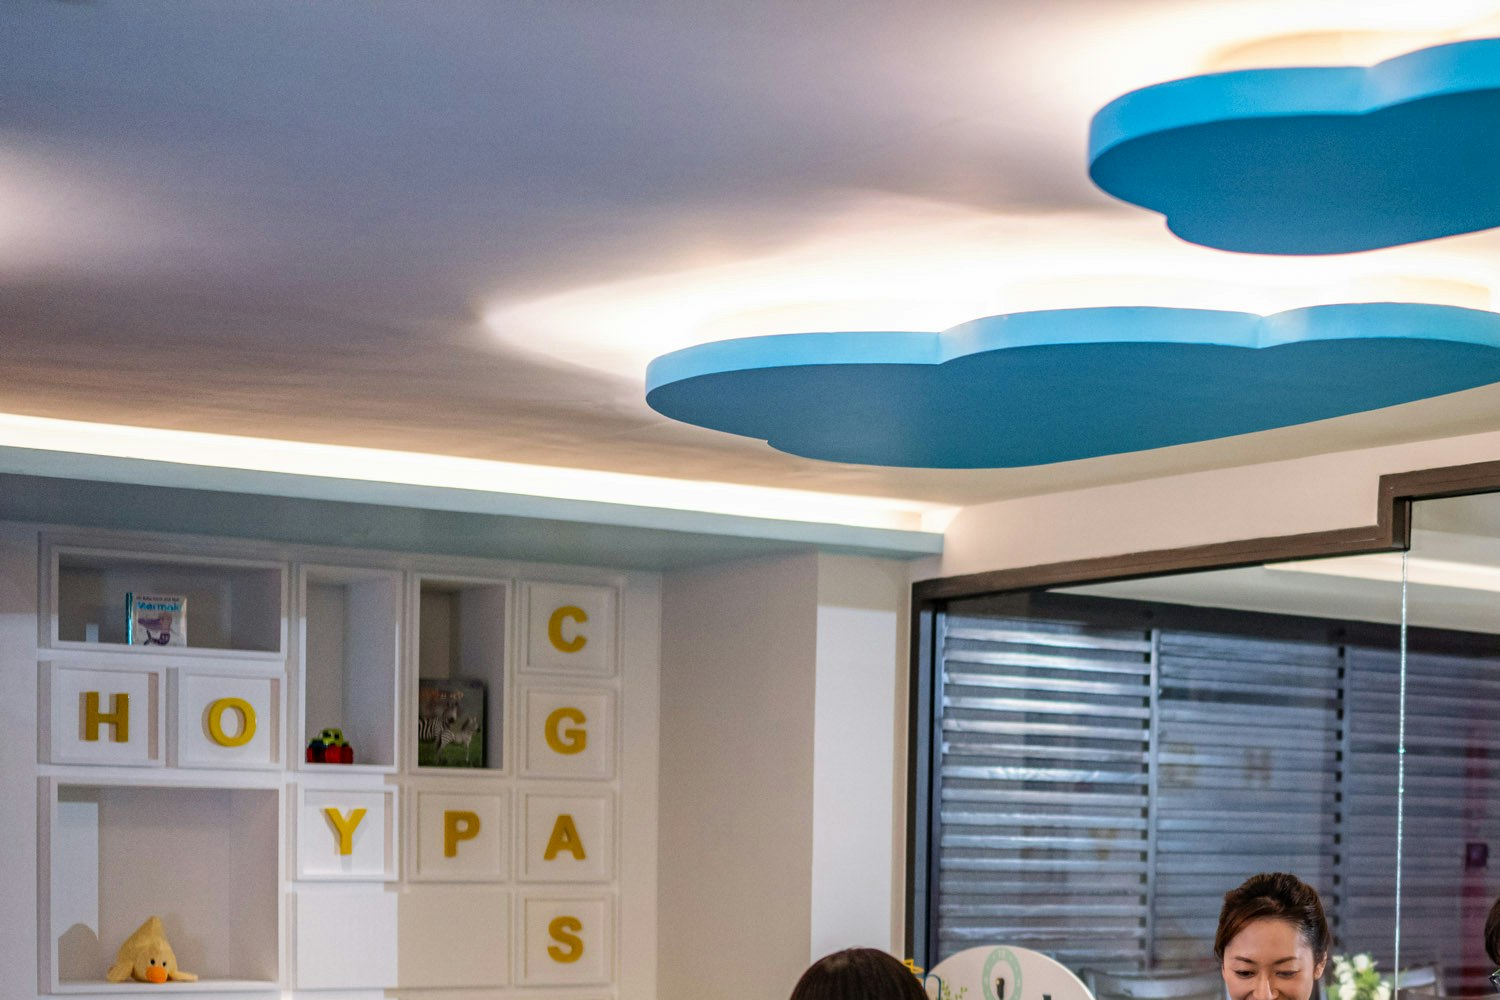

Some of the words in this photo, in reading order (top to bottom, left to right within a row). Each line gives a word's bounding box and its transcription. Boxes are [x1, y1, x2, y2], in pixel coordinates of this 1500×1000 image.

[548, 606, 588, 653] C
[85, 691, 129, 743] H
[208, 697, 257, 747] O
[545, 707, 587, 755] G
[325, 807, 367, 855] Y
[444, 810, 480, 857] P
[543, 814, 587, 860] A
[547, 916, 585, 963] S
